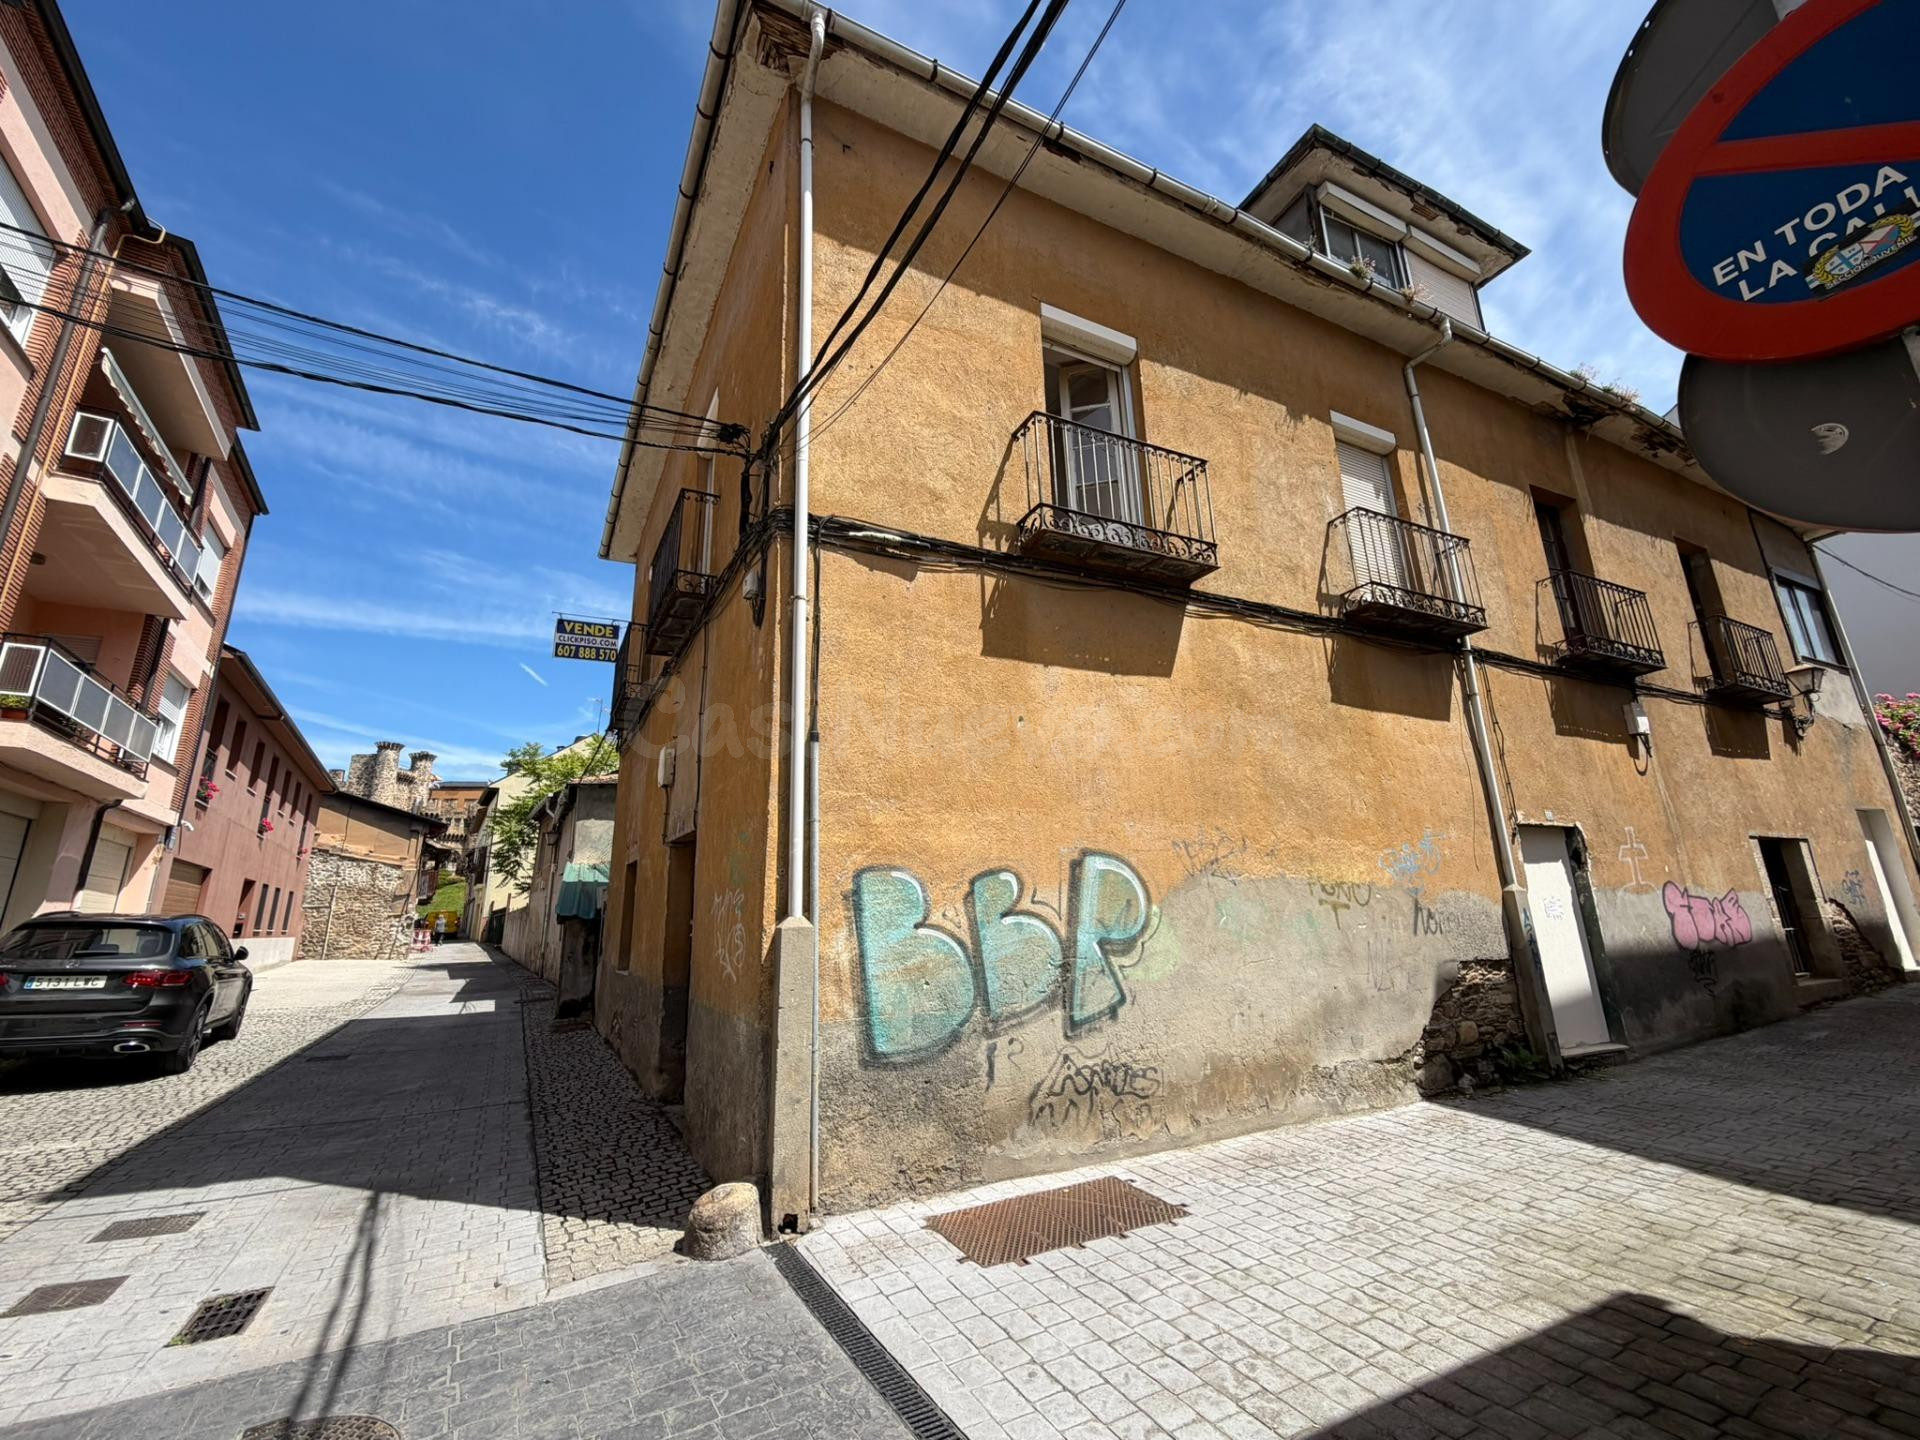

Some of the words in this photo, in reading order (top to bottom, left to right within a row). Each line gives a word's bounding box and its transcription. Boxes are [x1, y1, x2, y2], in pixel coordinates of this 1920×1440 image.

[1712, 240, 1768, 286] EN
[1774, 165, 1908, 247] TODA
[1738, 259, 1799, 302] LA
[563, 621, 615, 638] VENDE
[558, 634, 617, 648] CLICKPISO.COM
[557, 644, 576, 657] 607
[578, 647, 597, 660] 888
[598, 649, 617, 662] 570
